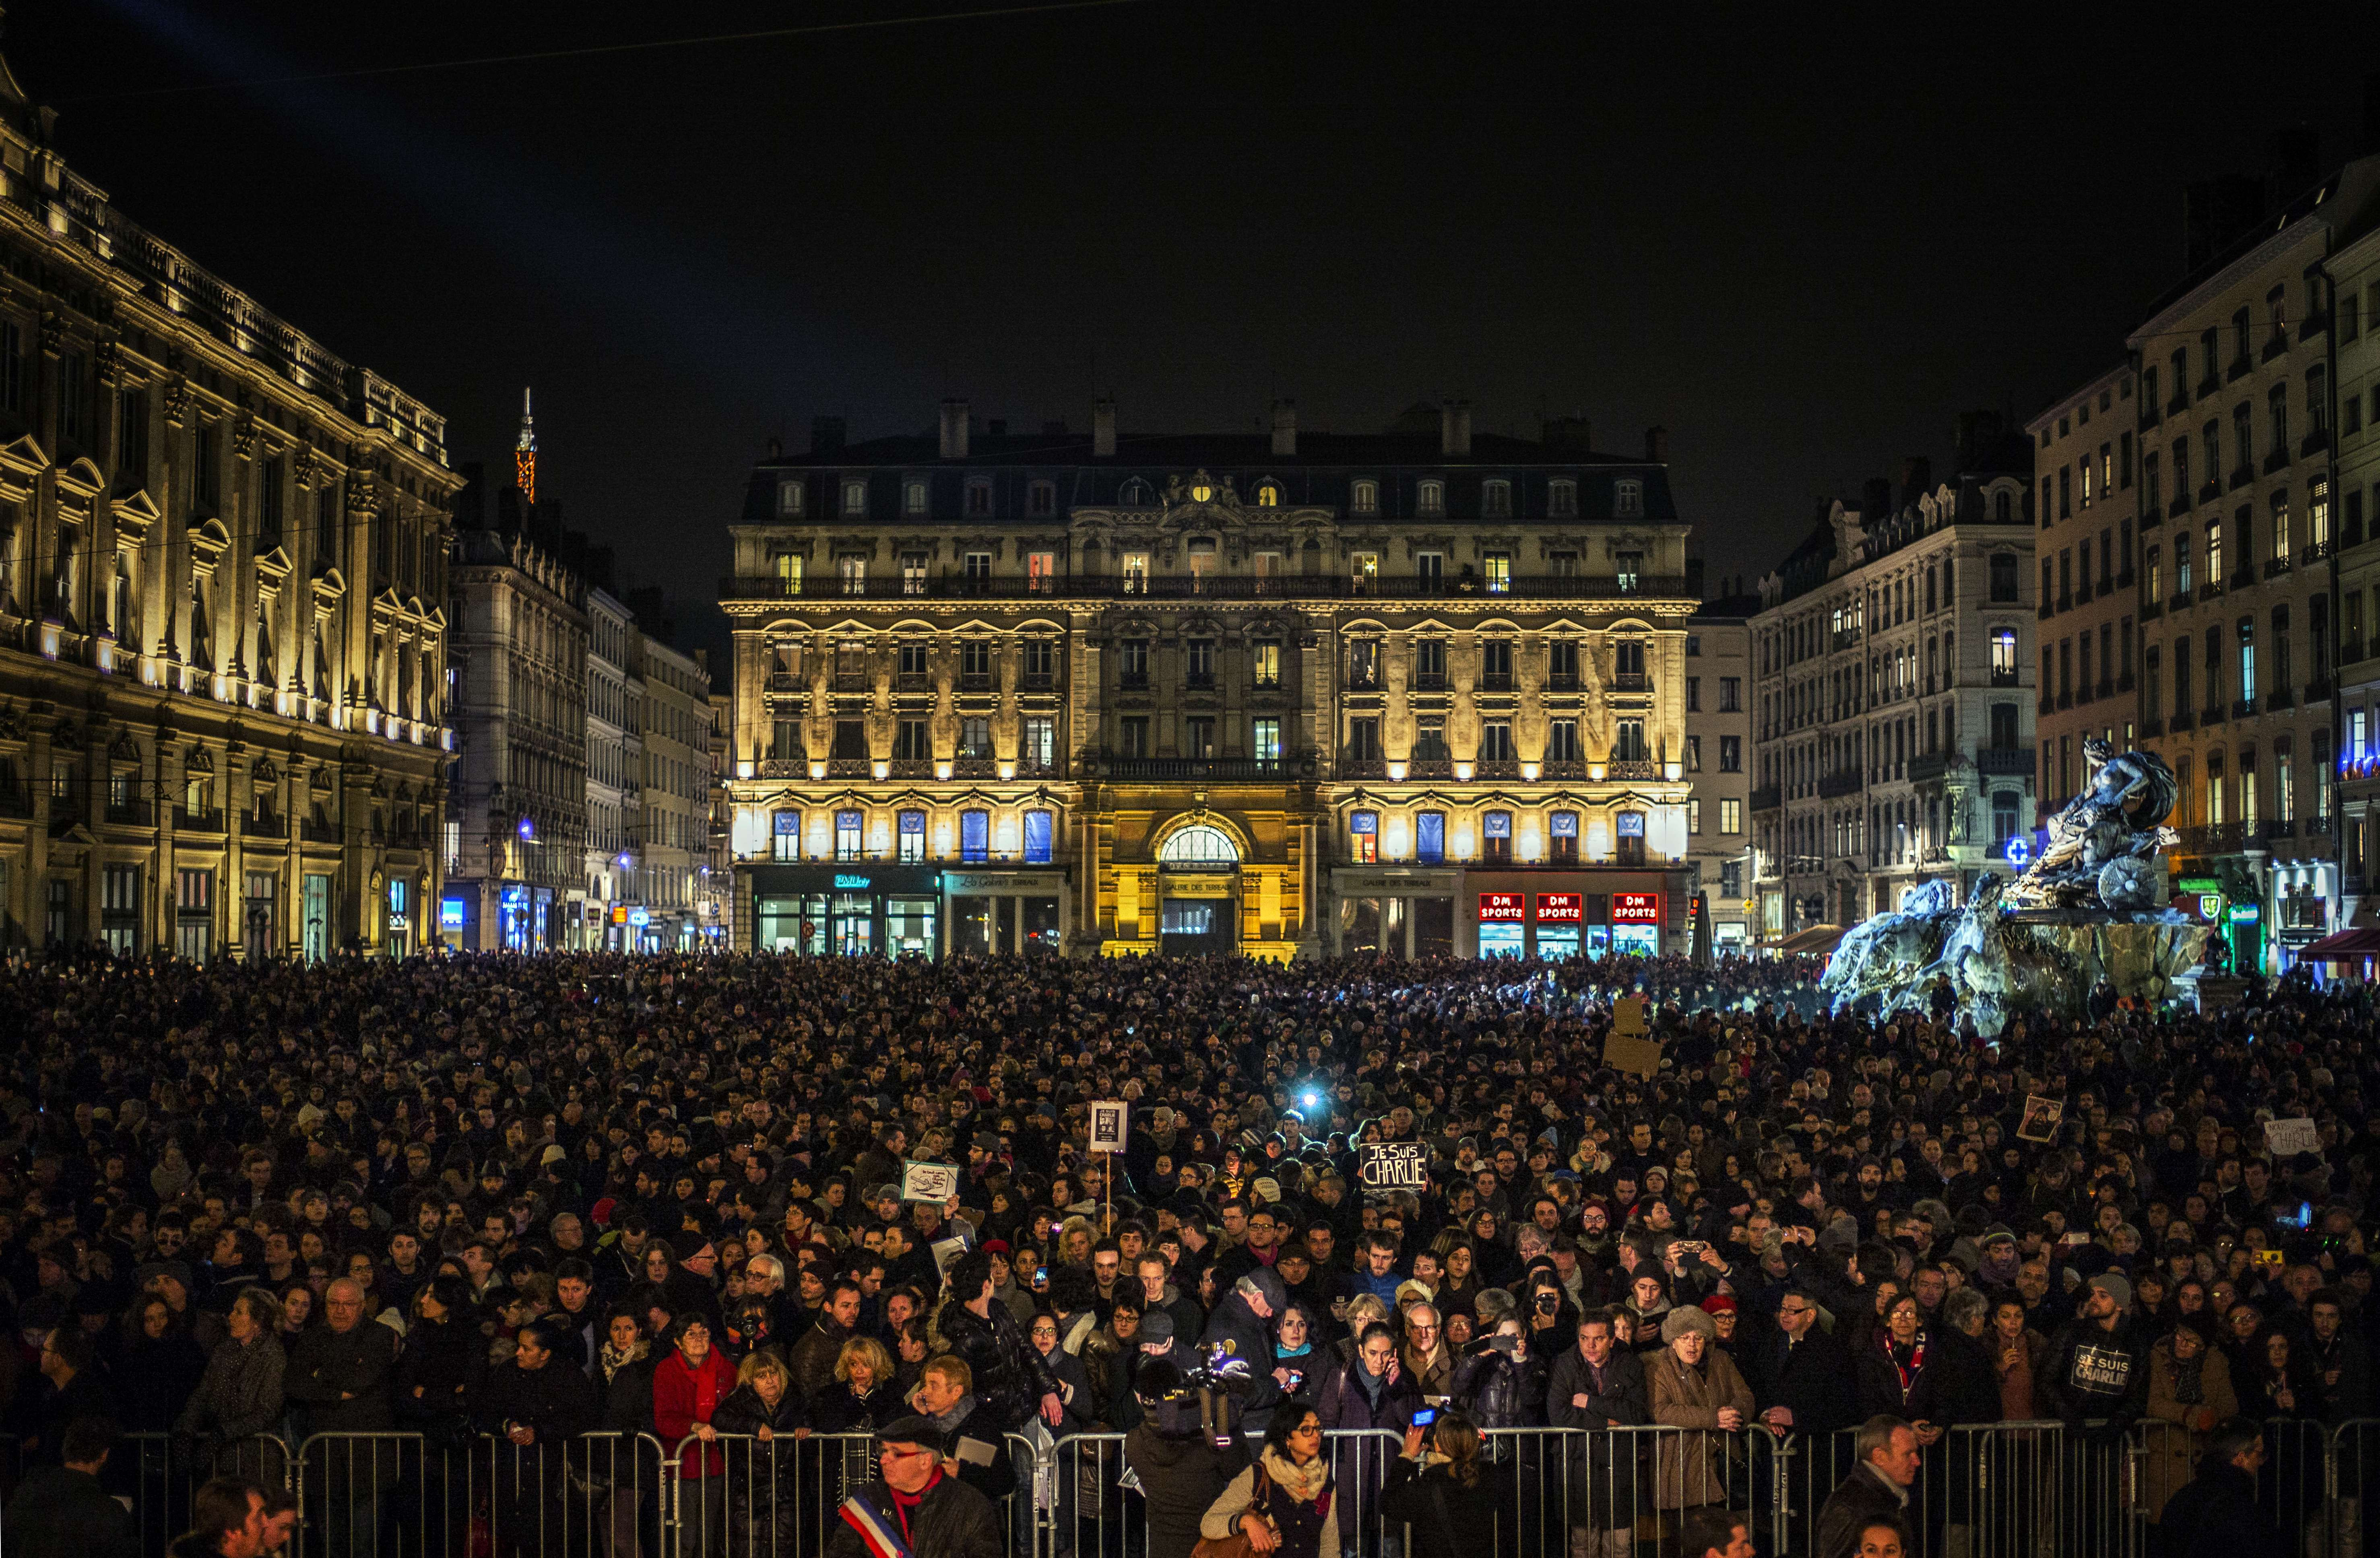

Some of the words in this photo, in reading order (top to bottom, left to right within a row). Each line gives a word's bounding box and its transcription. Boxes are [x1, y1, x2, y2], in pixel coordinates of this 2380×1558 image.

[1492, 896, 1511, 906] DM
[1550, 896, 1568, 906] DM
[1626, 896, 1645, 906] DM
[1481, 908, 1523, 918] SPORTS
[1538, 908, 1580, 918] SPORTS
[1614, 908, 1656, 918] SPORTS
[2098, 1358, 2129, 1372] SUIS
[2076, 1365, 2127, 1386] CHARLIE
